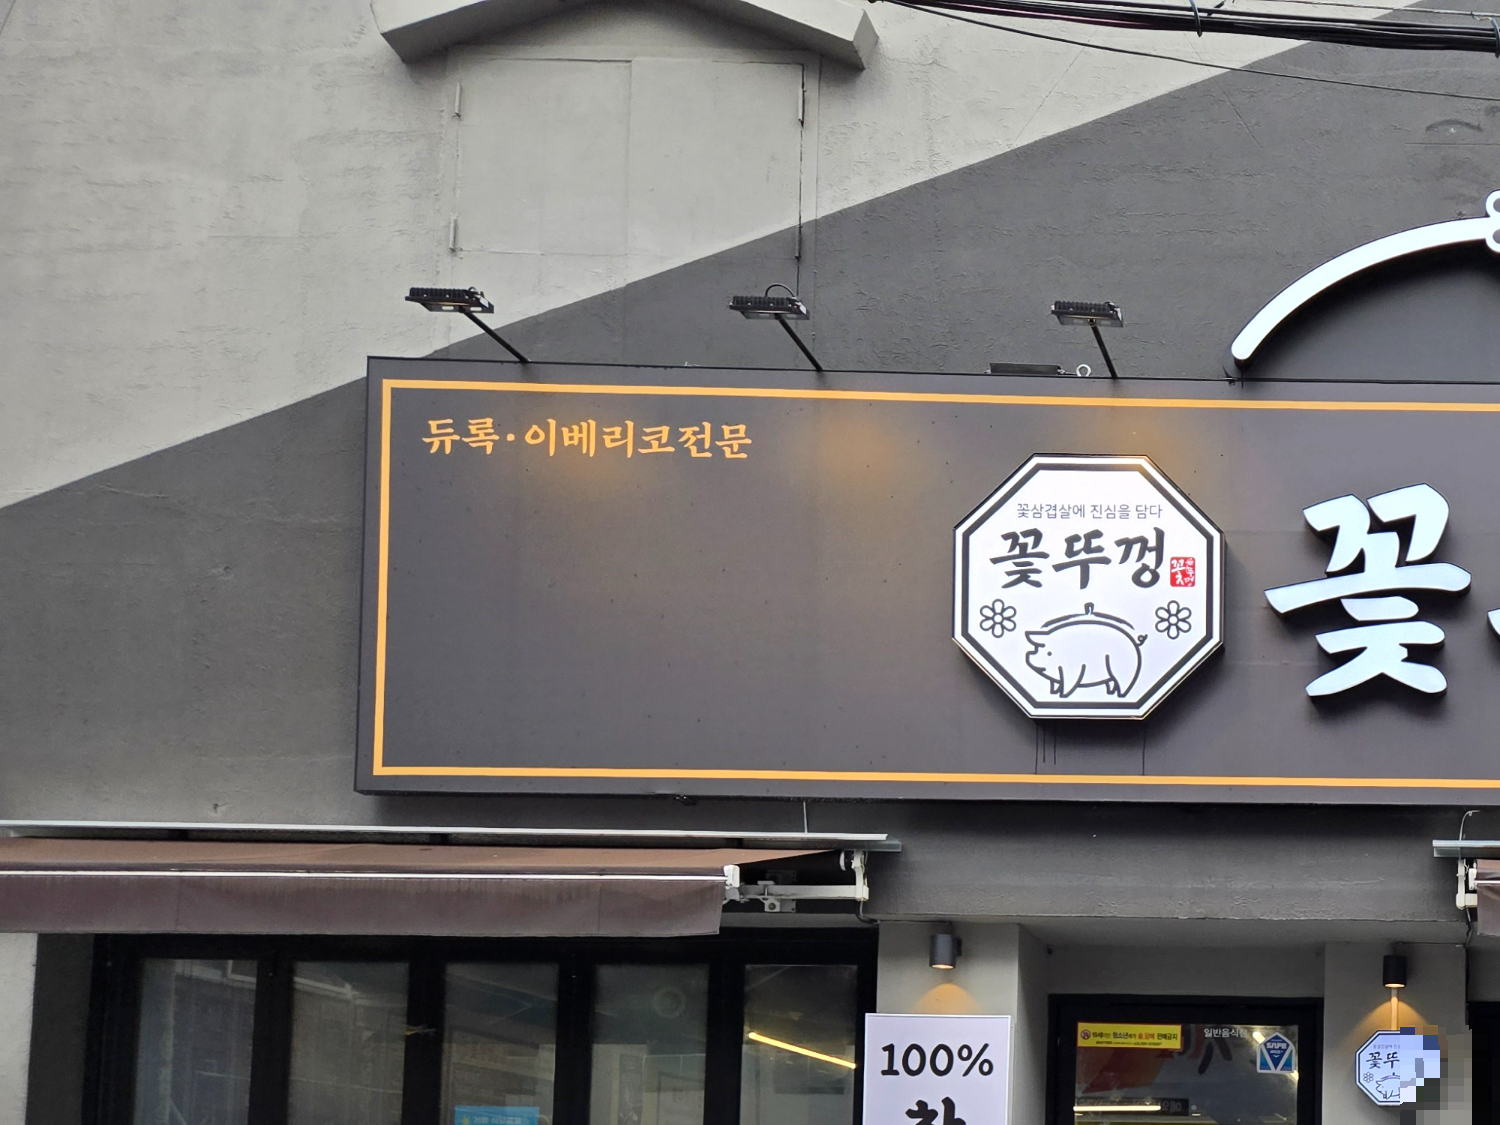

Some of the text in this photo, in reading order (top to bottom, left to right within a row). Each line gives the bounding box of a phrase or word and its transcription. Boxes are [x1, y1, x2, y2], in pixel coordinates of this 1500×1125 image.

[1016, 503, 1163, 519] 꽃삼겹살에 진심을 담다
[989, 527, 1165, 590] 꽃뚜껑
[880, 1042, 995, 1078] 100%
